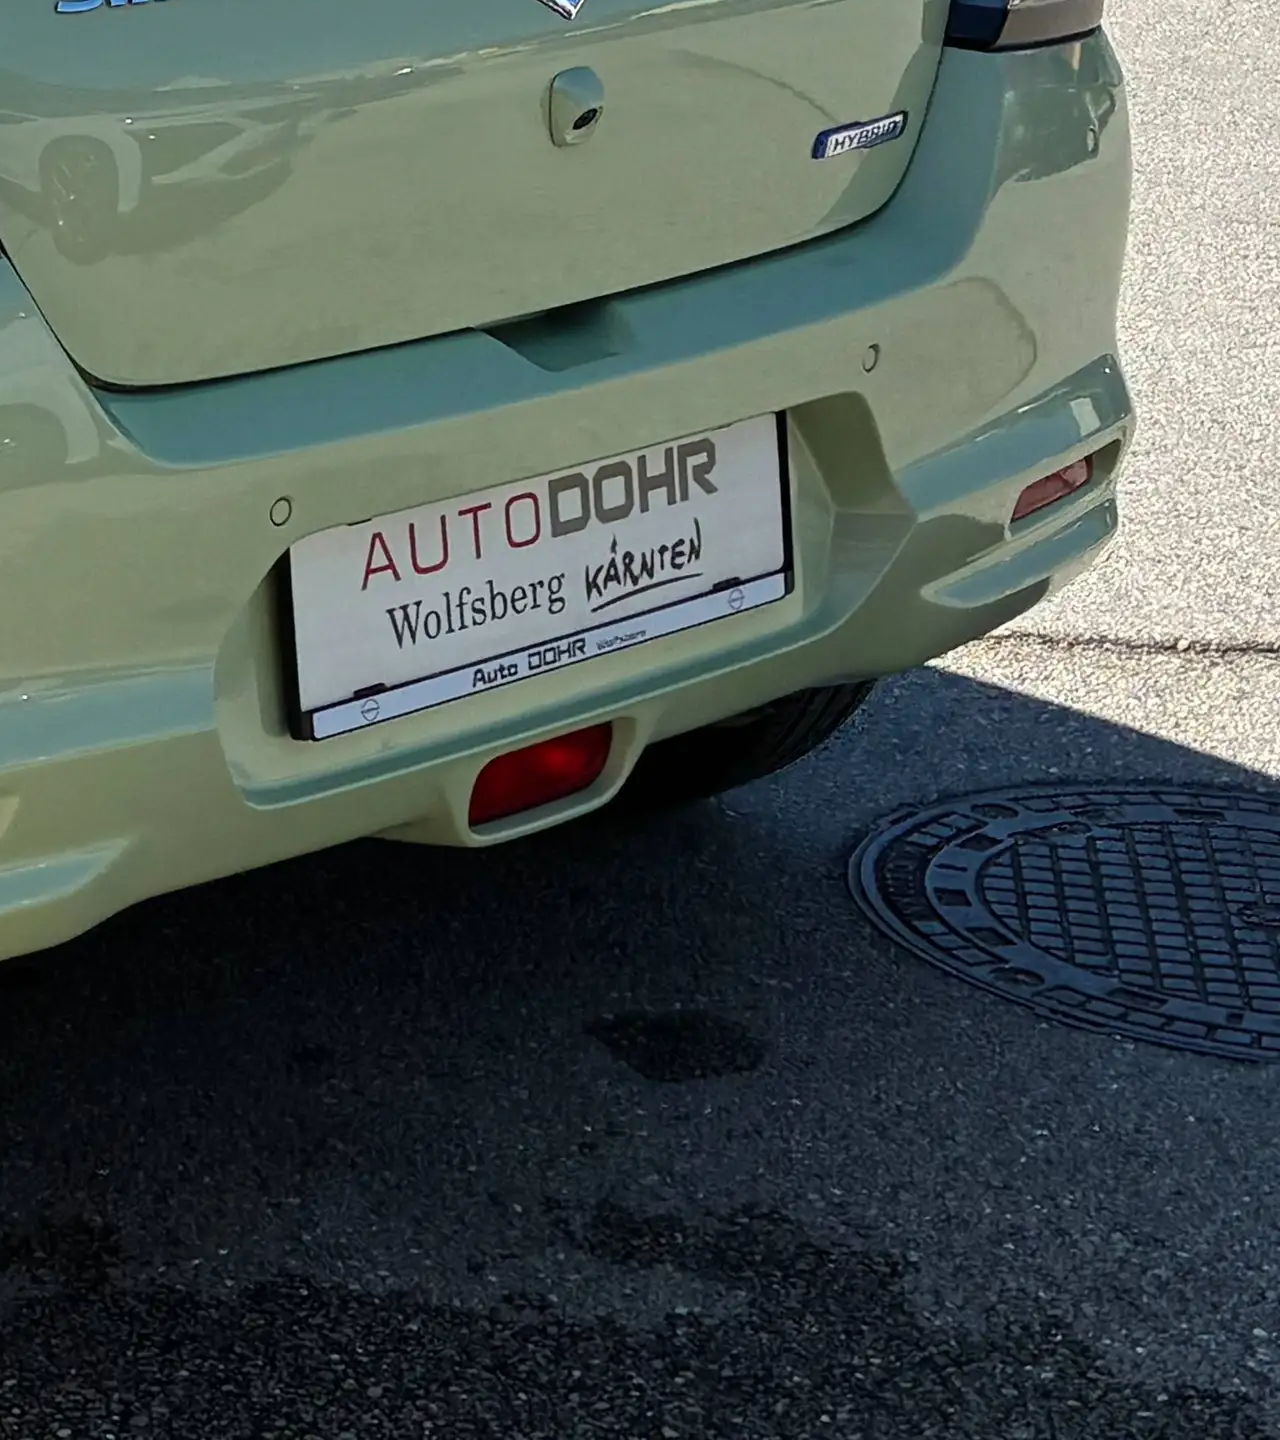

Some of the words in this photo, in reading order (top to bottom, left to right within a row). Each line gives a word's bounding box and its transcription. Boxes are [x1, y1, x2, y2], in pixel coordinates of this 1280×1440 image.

[833, 119, 901, 152] HYBRID
[386, 573, 565, 649] Wolfsberg
[472, 664, 519, 688] Auto
[528, 638, 587, 670] DOHR
